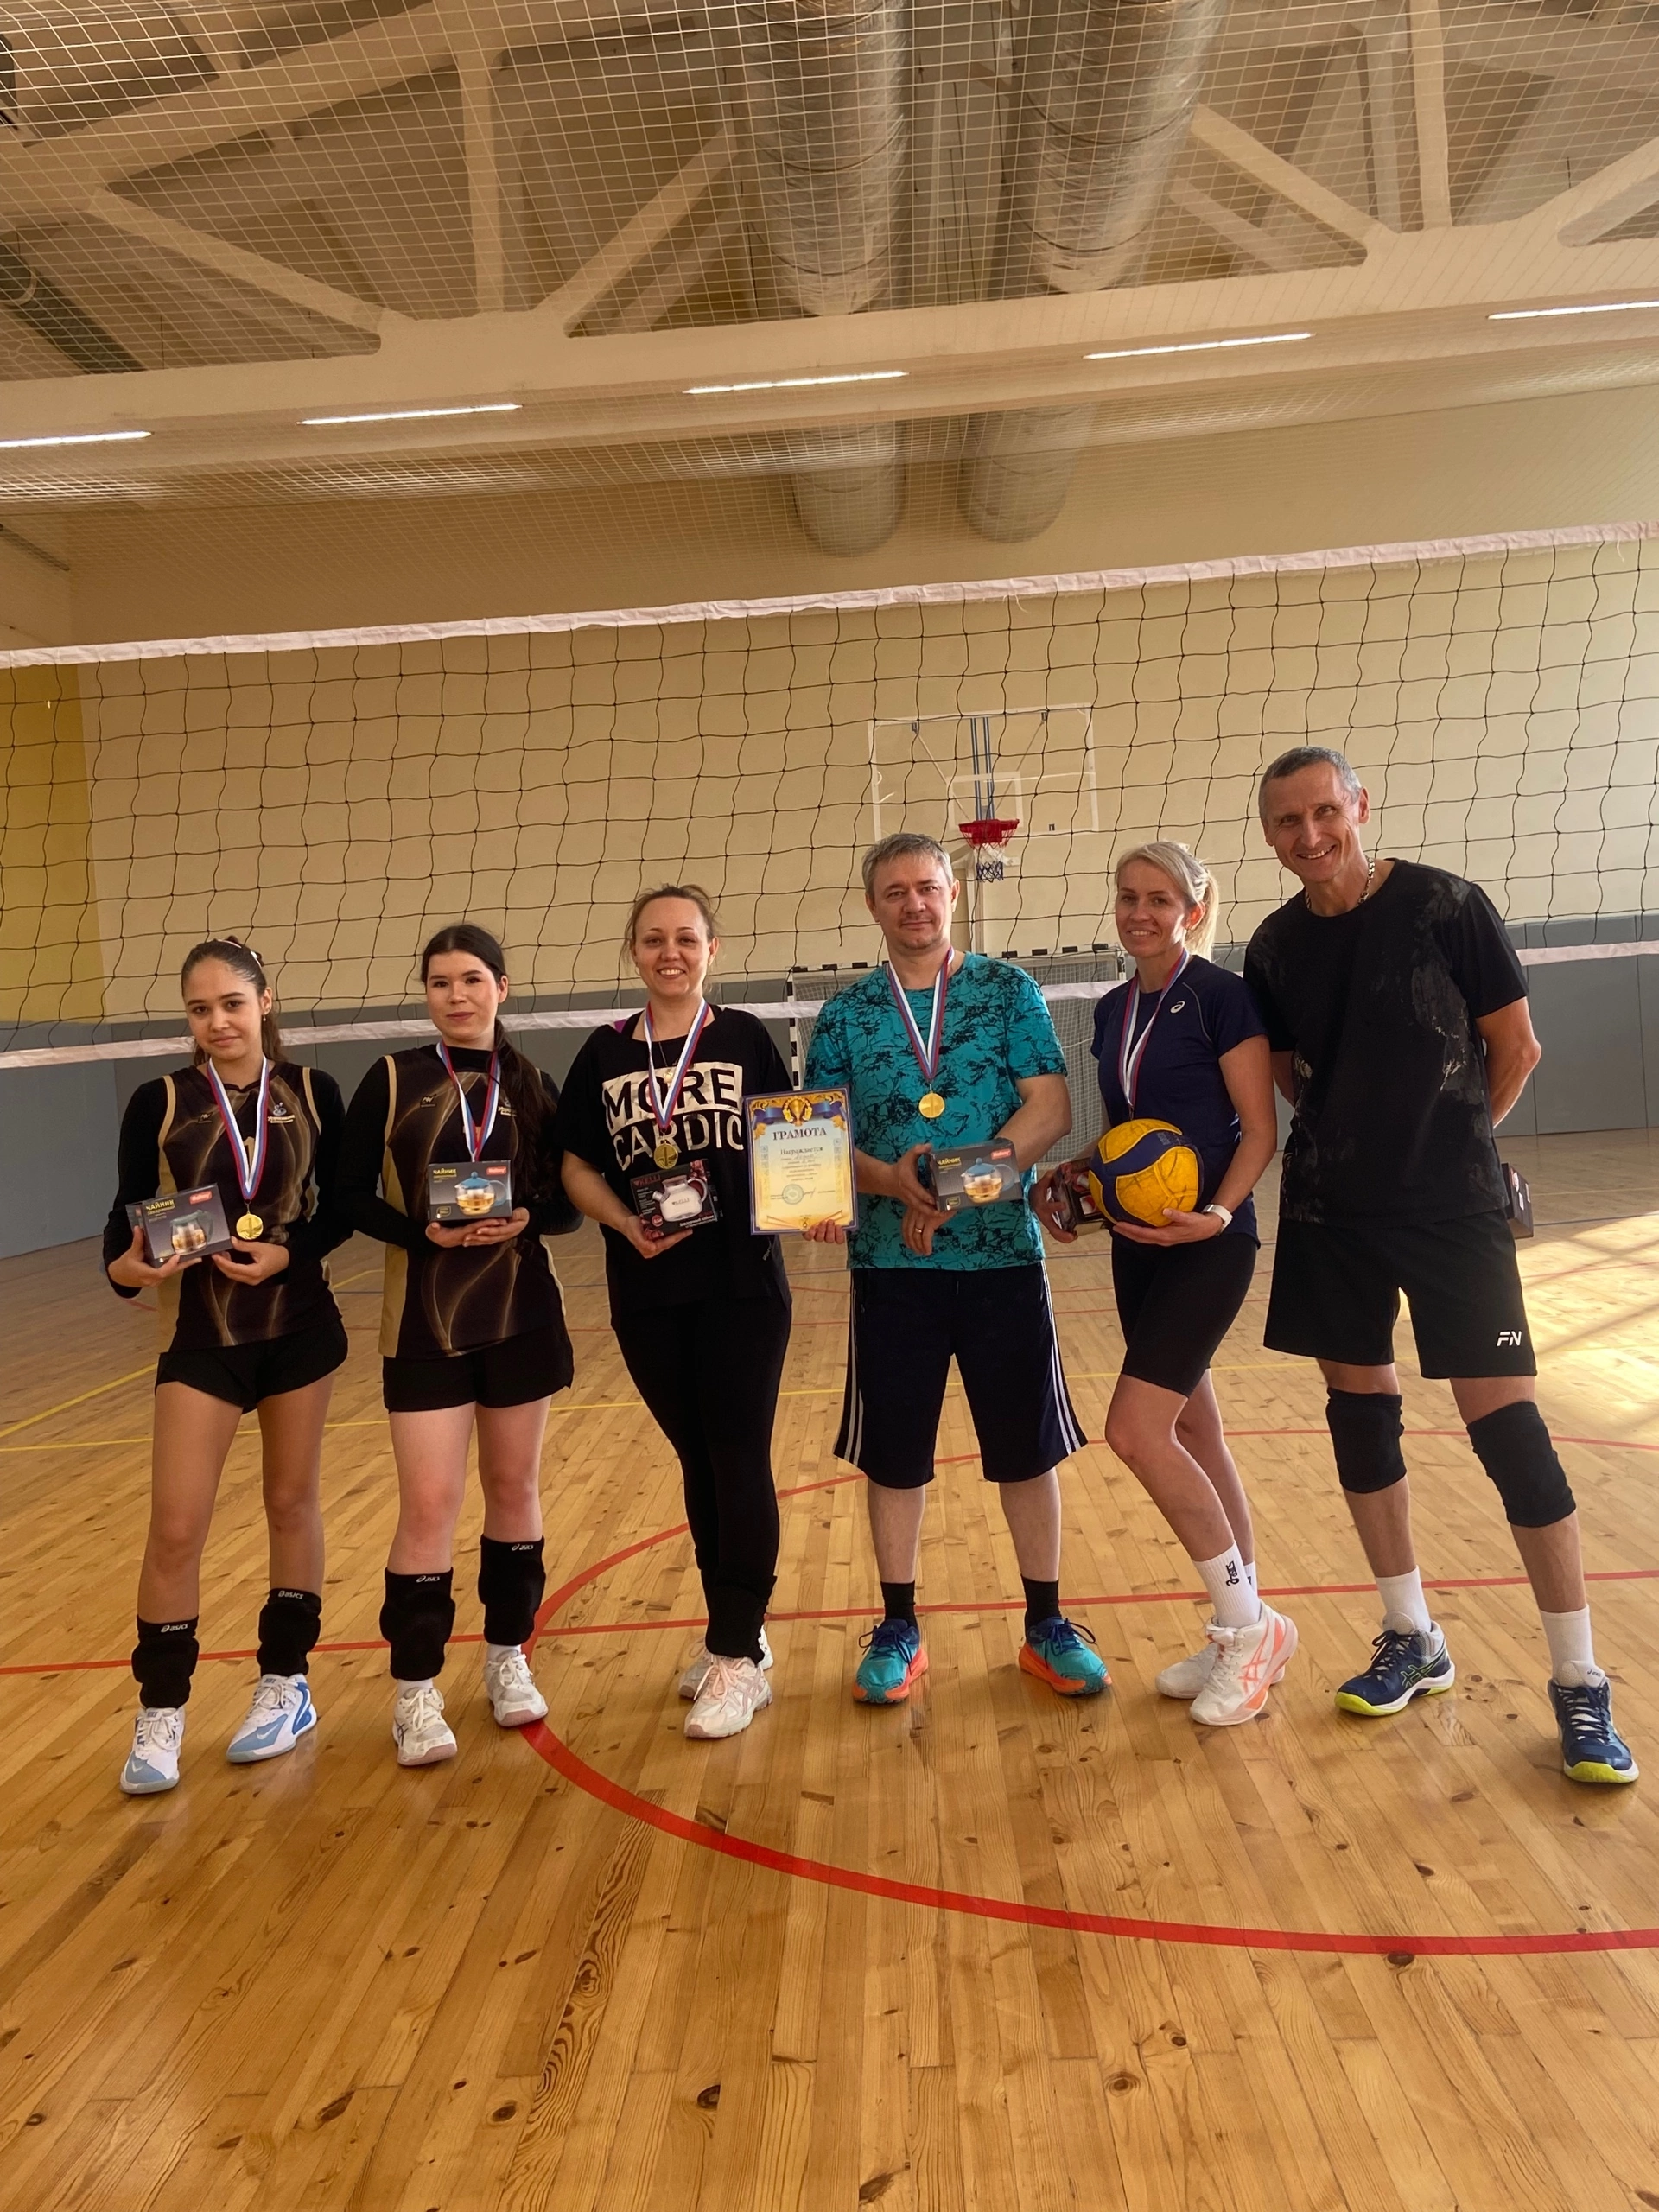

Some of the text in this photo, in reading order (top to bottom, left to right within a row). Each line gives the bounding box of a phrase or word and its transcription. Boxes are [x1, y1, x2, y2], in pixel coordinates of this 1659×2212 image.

[604, 1068, 739, 1129] MORE
[772, 1127, 827, 1141] ГРАМОТА
[145, 1199, 175, 1211] ЧАЙНИК
[1497, 1331, 1522, 1346] FN
